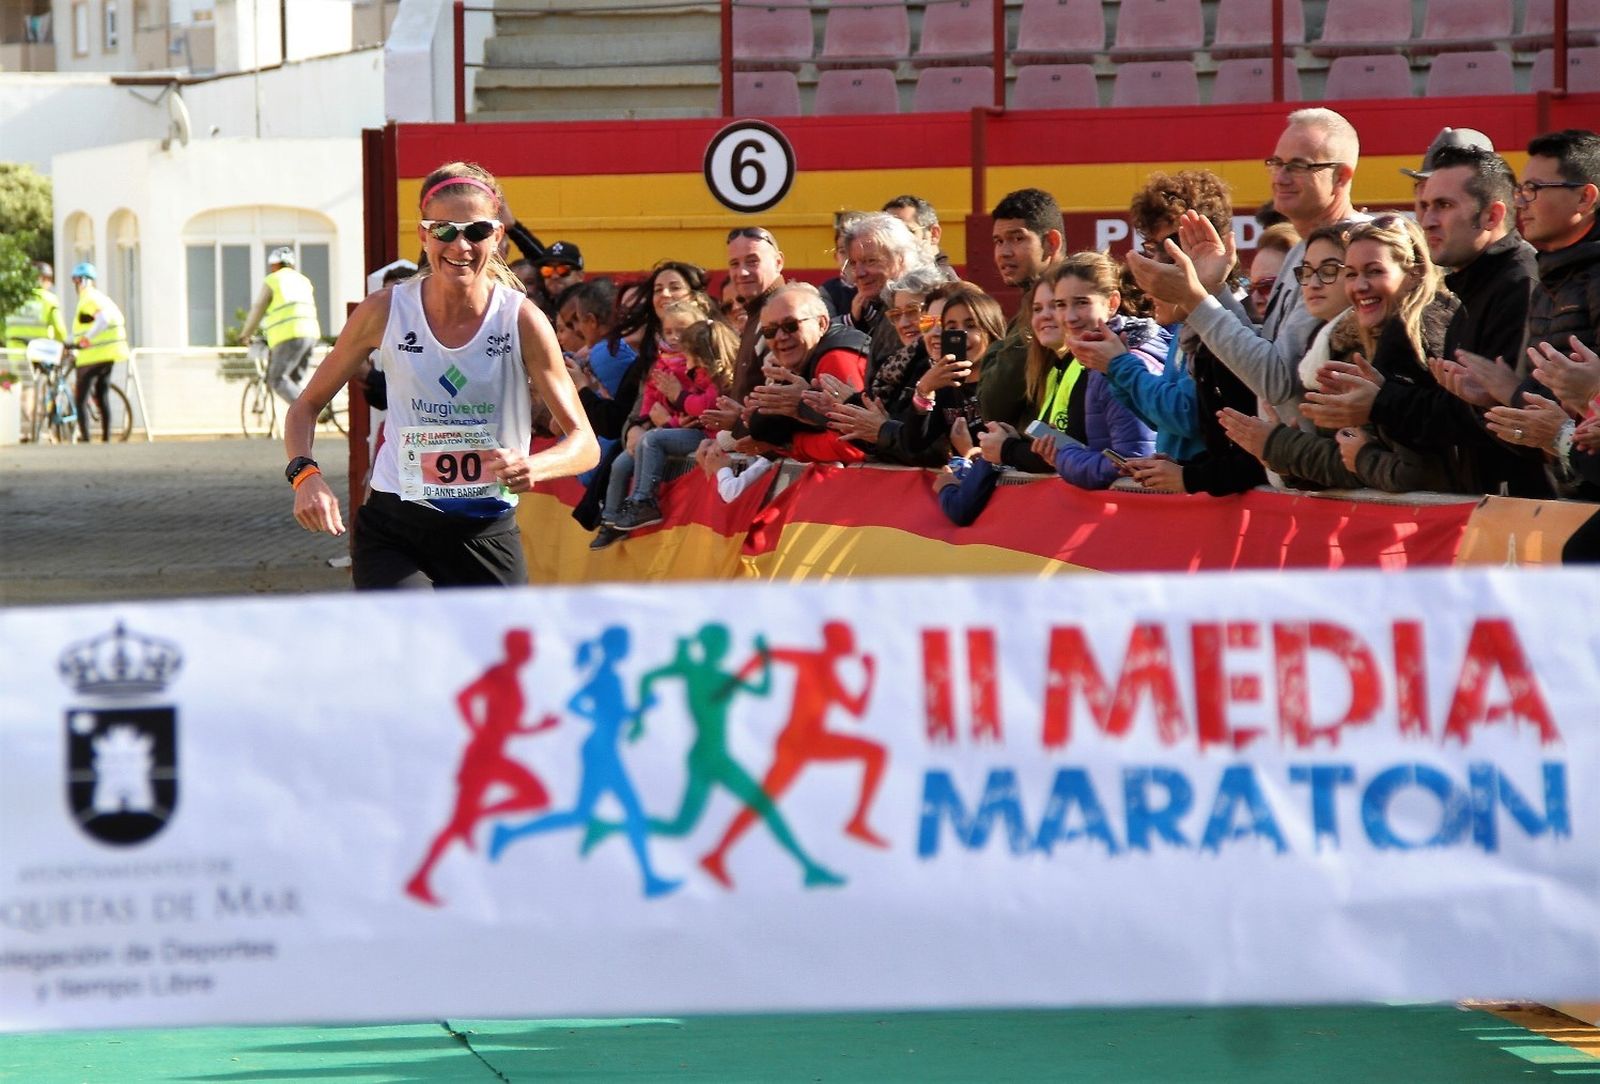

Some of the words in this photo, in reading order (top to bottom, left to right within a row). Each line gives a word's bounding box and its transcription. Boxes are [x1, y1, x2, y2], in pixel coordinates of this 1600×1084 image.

[731, 139, 766, 195] 6
[412, 399, 495, 417] Murgiverde
[428, 438, 463, 446] MARATON
[434, 432, 462, 440] MEDIA
[436, 453, 481, 484] 90
[423, 486, 456, 497] JO-ANNE
[919, 627, 1001, 746] II
[1042, 617, 1565, 751] MEDIA
[917, 761, 1571, 859] MARATON
